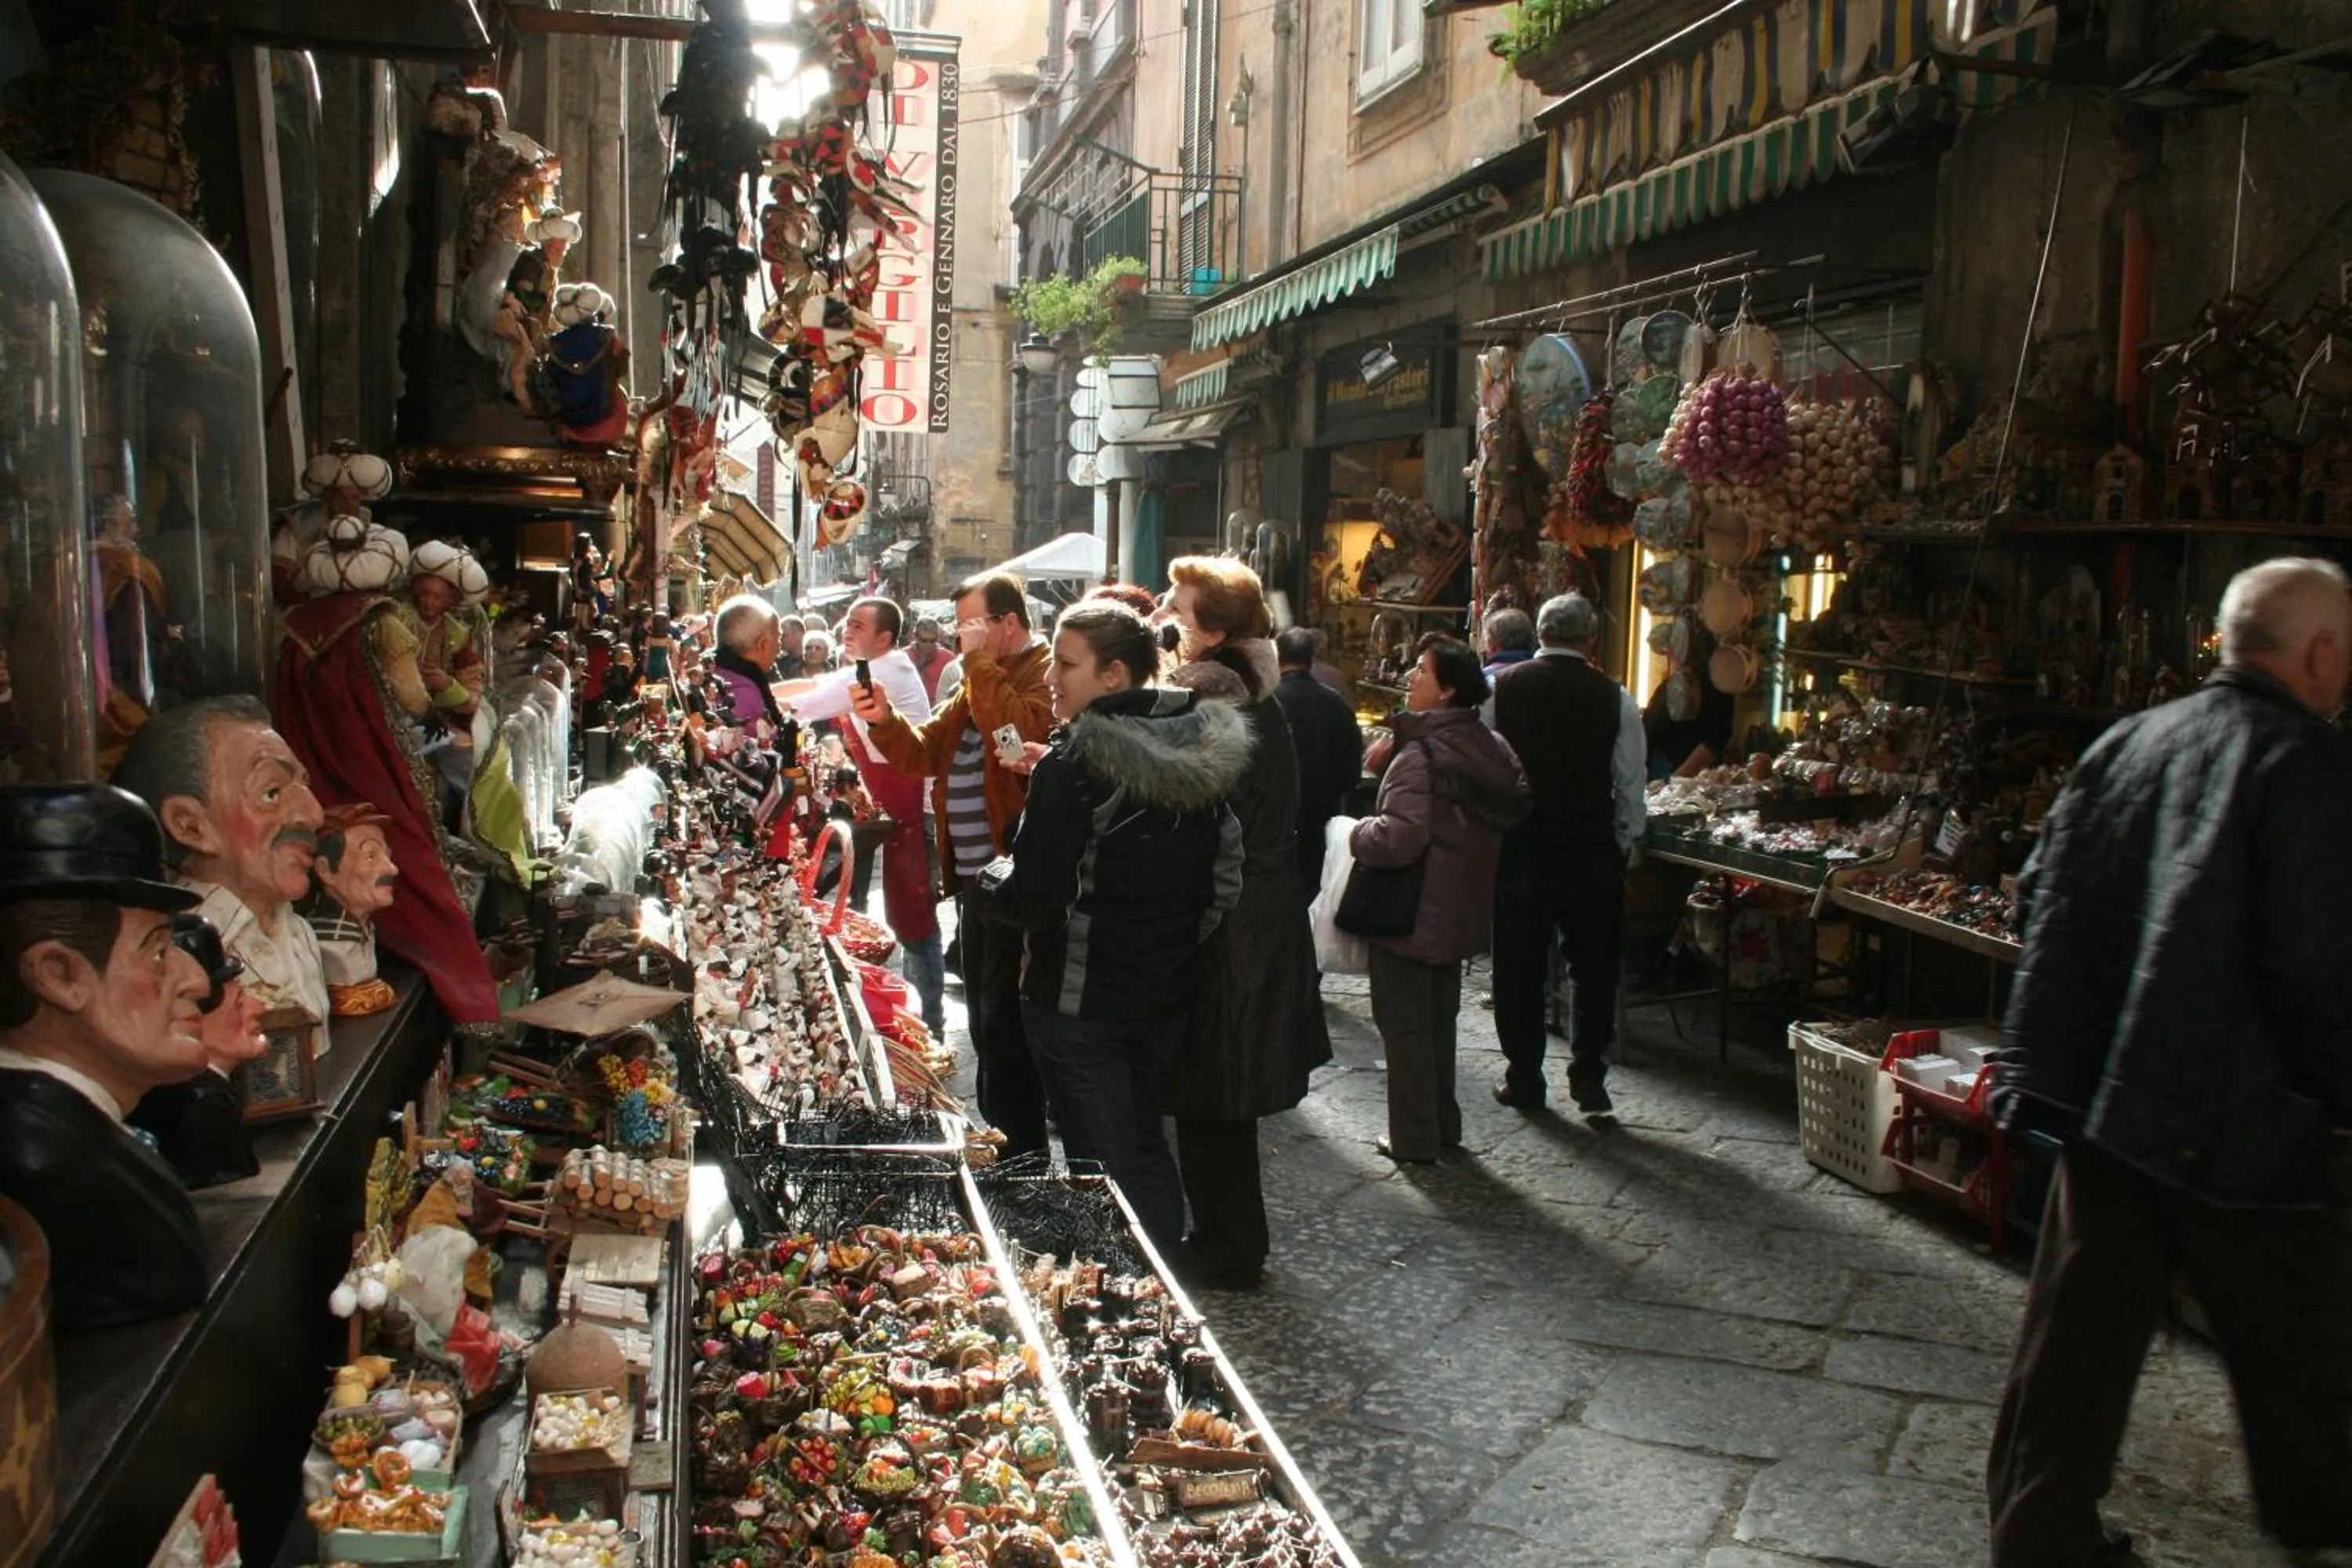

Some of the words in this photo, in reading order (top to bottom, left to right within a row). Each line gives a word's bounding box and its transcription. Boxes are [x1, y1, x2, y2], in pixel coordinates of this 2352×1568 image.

[942, 63, 958, 111] 1830
[942, 120, 957, 165] DAL
[935, 175, 956, 294] GENNARO
[862, 151, 927, 426] VGILIO
[938, 303, 952, 314] E
[932, 323, 952, 427] ROSARIO
